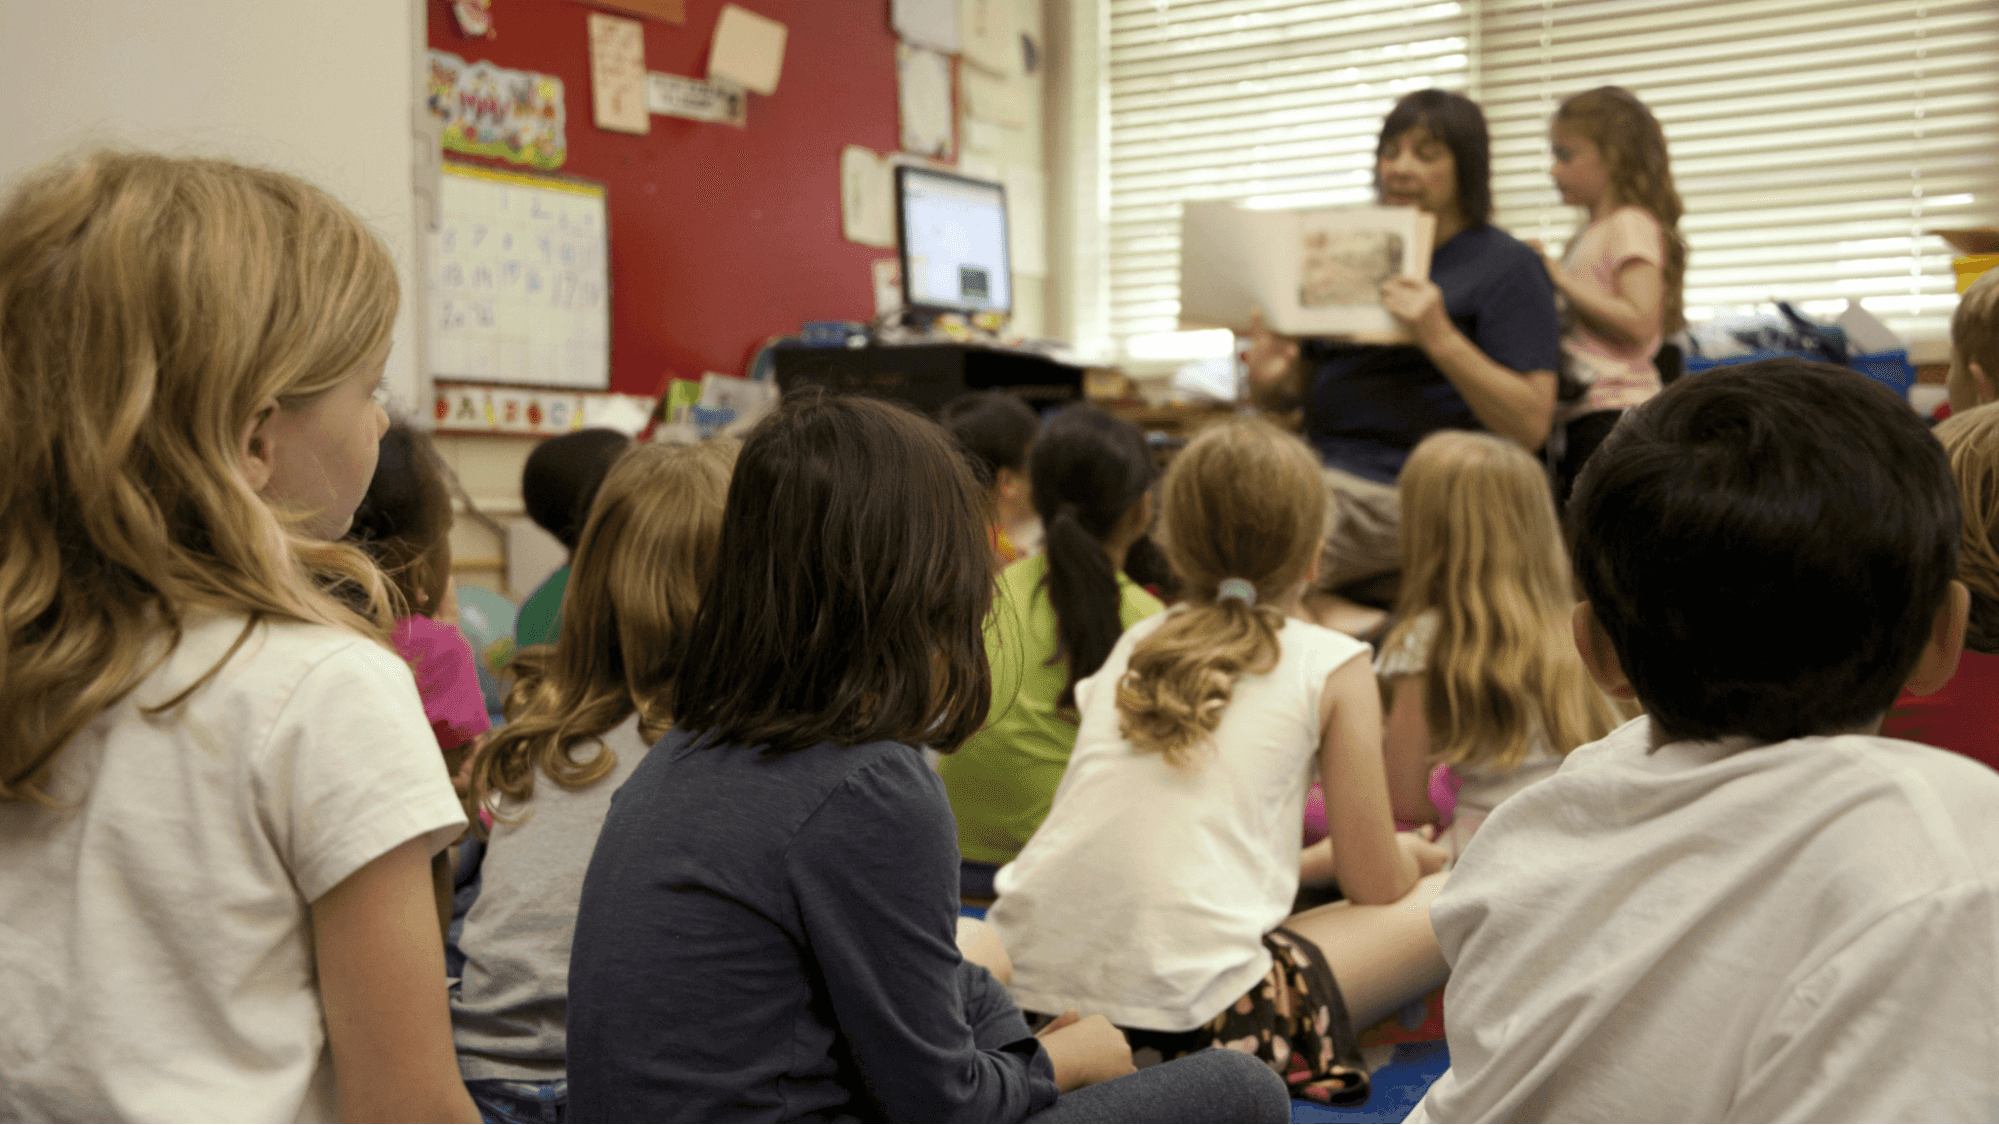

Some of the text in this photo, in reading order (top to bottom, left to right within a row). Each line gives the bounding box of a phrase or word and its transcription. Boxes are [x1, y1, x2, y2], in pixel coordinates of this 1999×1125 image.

[457, 396, 569, 425] A B C
